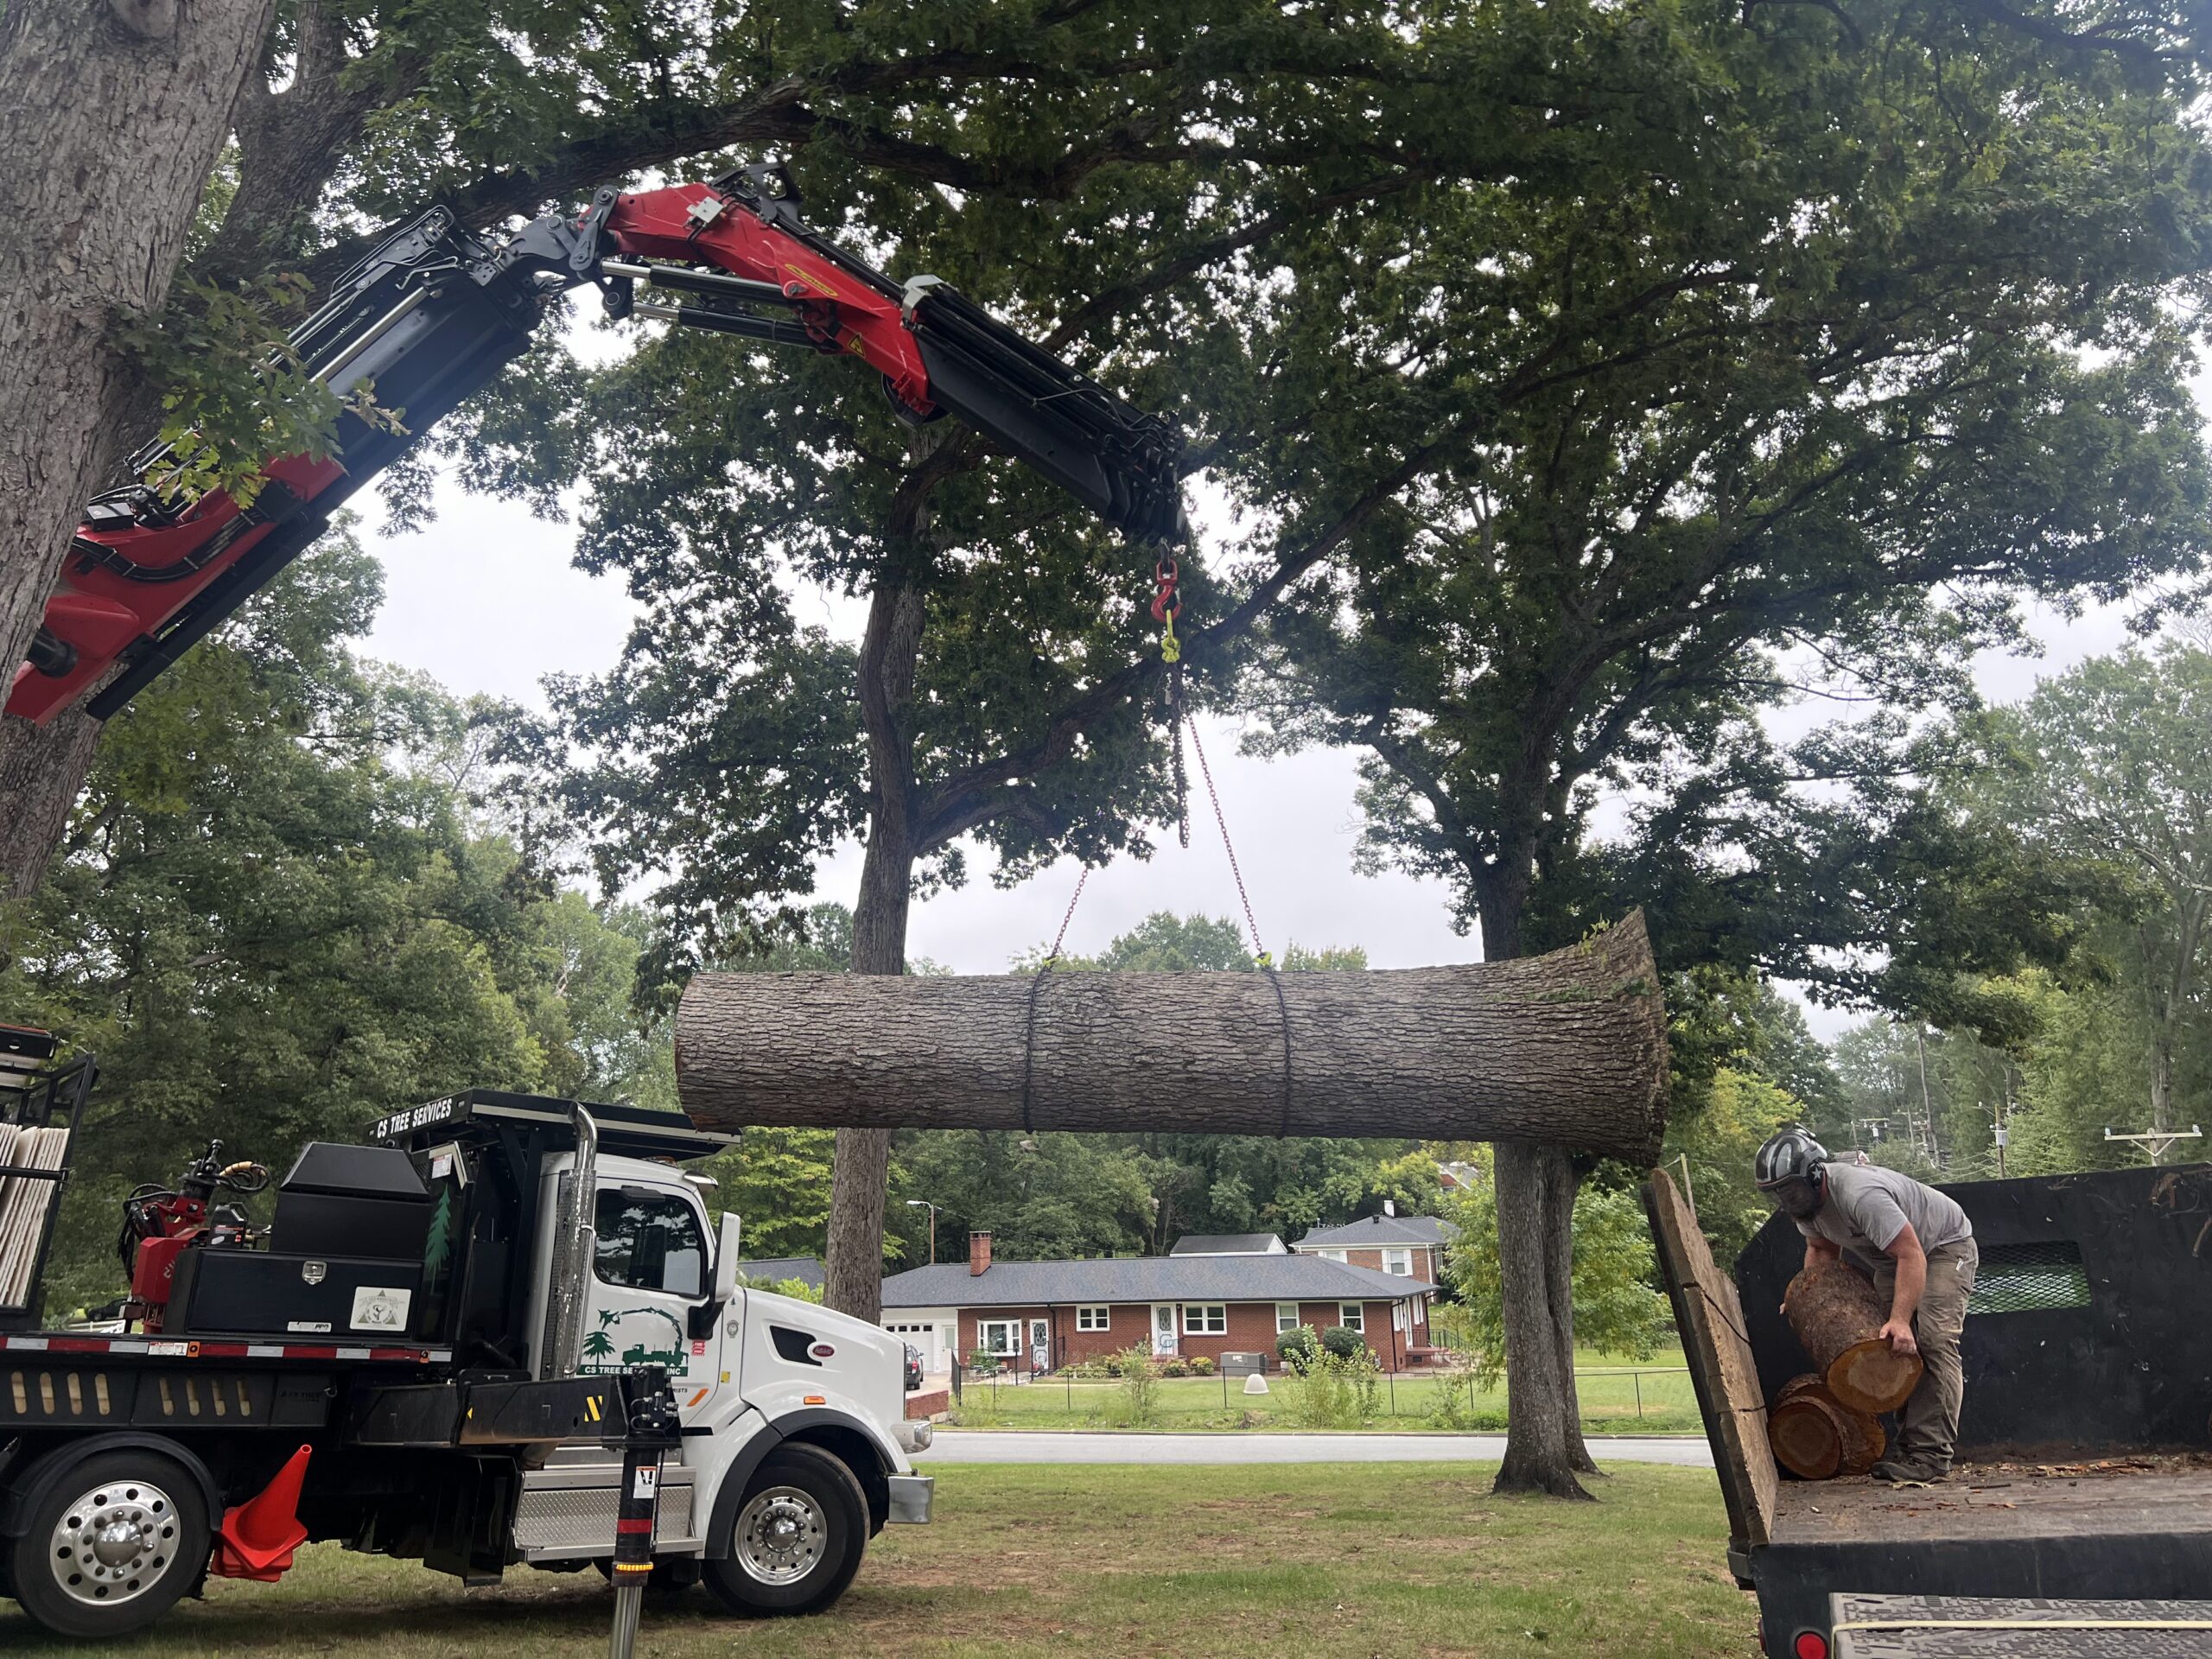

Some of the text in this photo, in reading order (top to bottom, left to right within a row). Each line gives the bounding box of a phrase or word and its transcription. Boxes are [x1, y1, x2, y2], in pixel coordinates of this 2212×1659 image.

[377, 1098, 452, 1138] CS TREE SERVICES
[666, 1367, 681, 1376] INC
